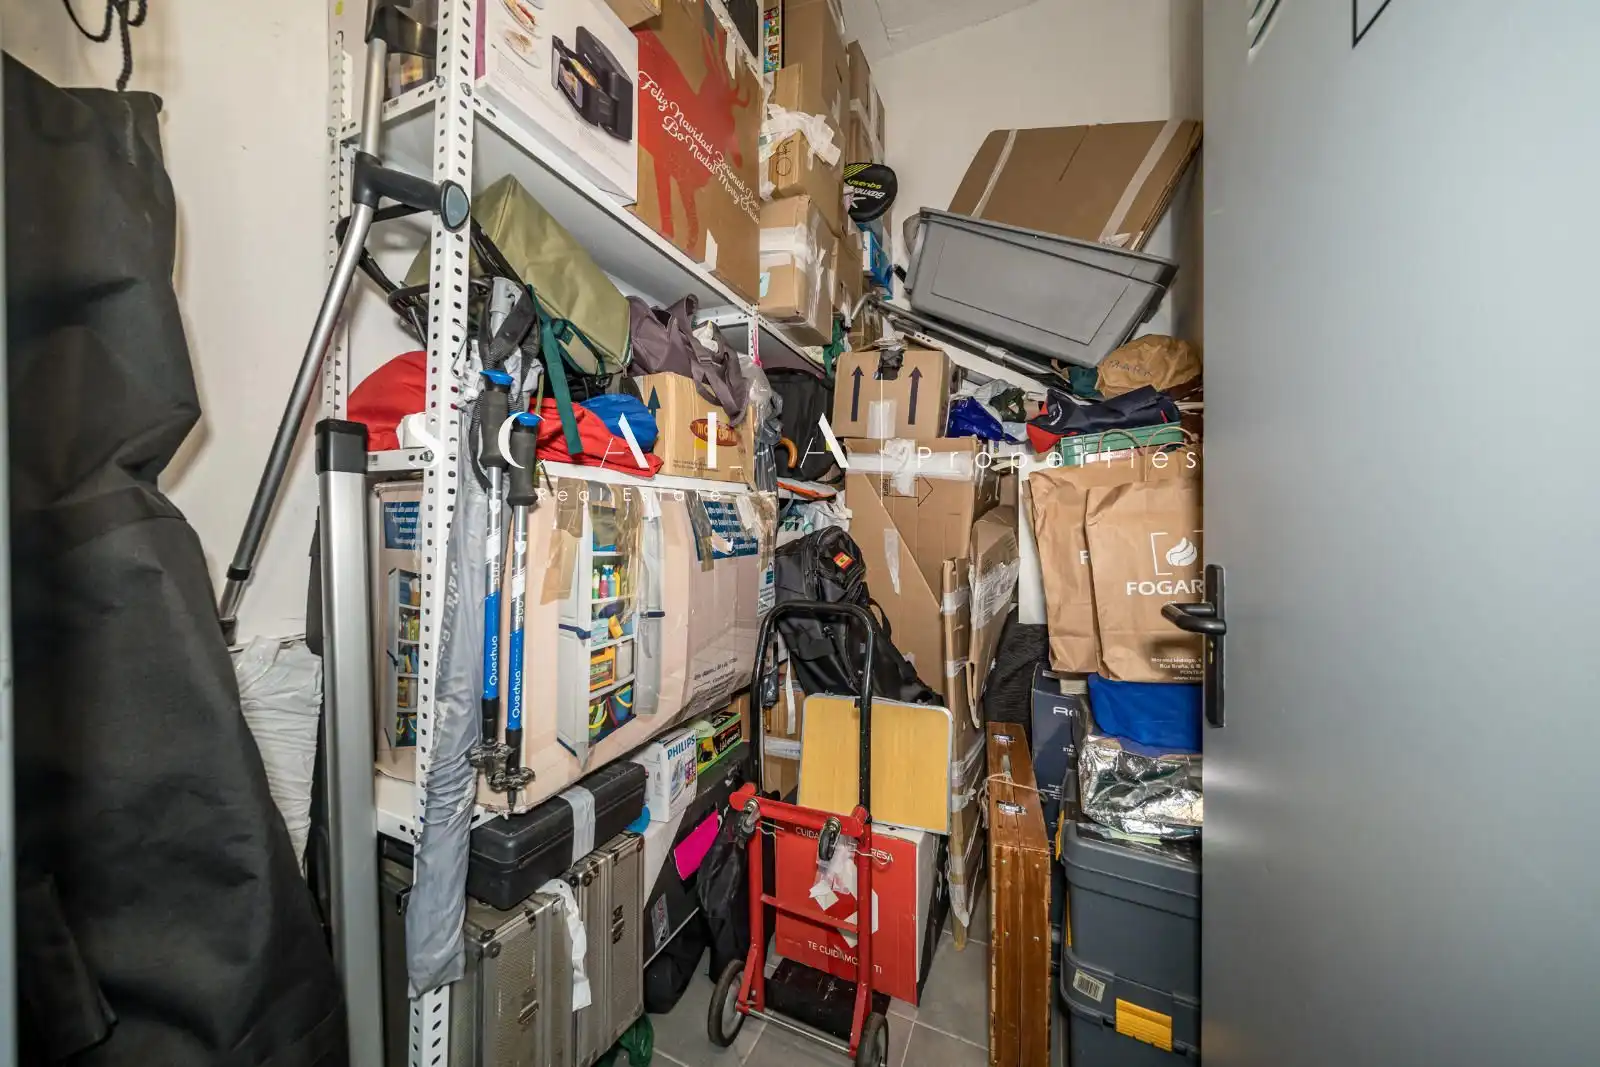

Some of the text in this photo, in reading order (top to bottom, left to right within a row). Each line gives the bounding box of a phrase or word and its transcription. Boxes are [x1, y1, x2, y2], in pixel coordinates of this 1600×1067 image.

[638, 70, 668, 111] Feliz
[669, 101, 713, 155] Navidad
[662, 115, 686, 141] Bo
[488, 635, 498, 686] Quechua
[511, 670, 521, 719] Quechua
[667, 734, 696, 760] PHILIPS
[807, 940, 818, 951] TE
